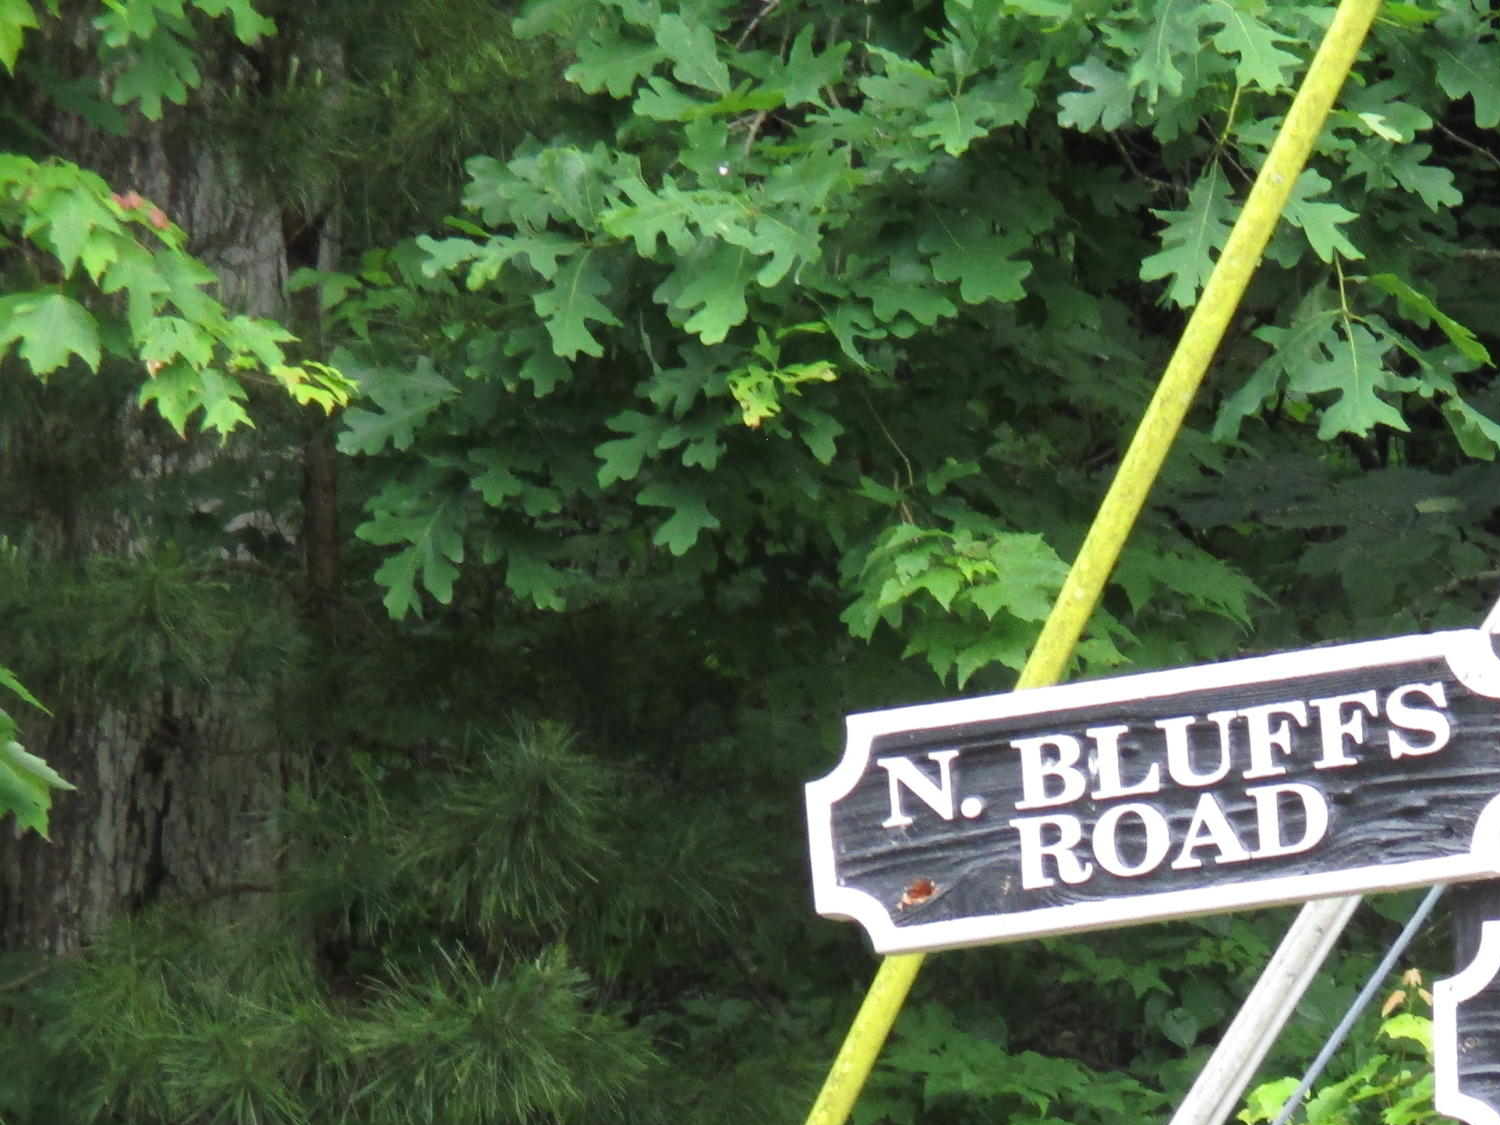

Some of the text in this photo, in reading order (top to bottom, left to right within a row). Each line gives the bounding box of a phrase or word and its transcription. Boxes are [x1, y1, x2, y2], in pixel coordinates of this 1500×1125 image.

[877, 681, 1453, 830] N. BLUFFS
[1009, 782, 1330, 890] ROAD
